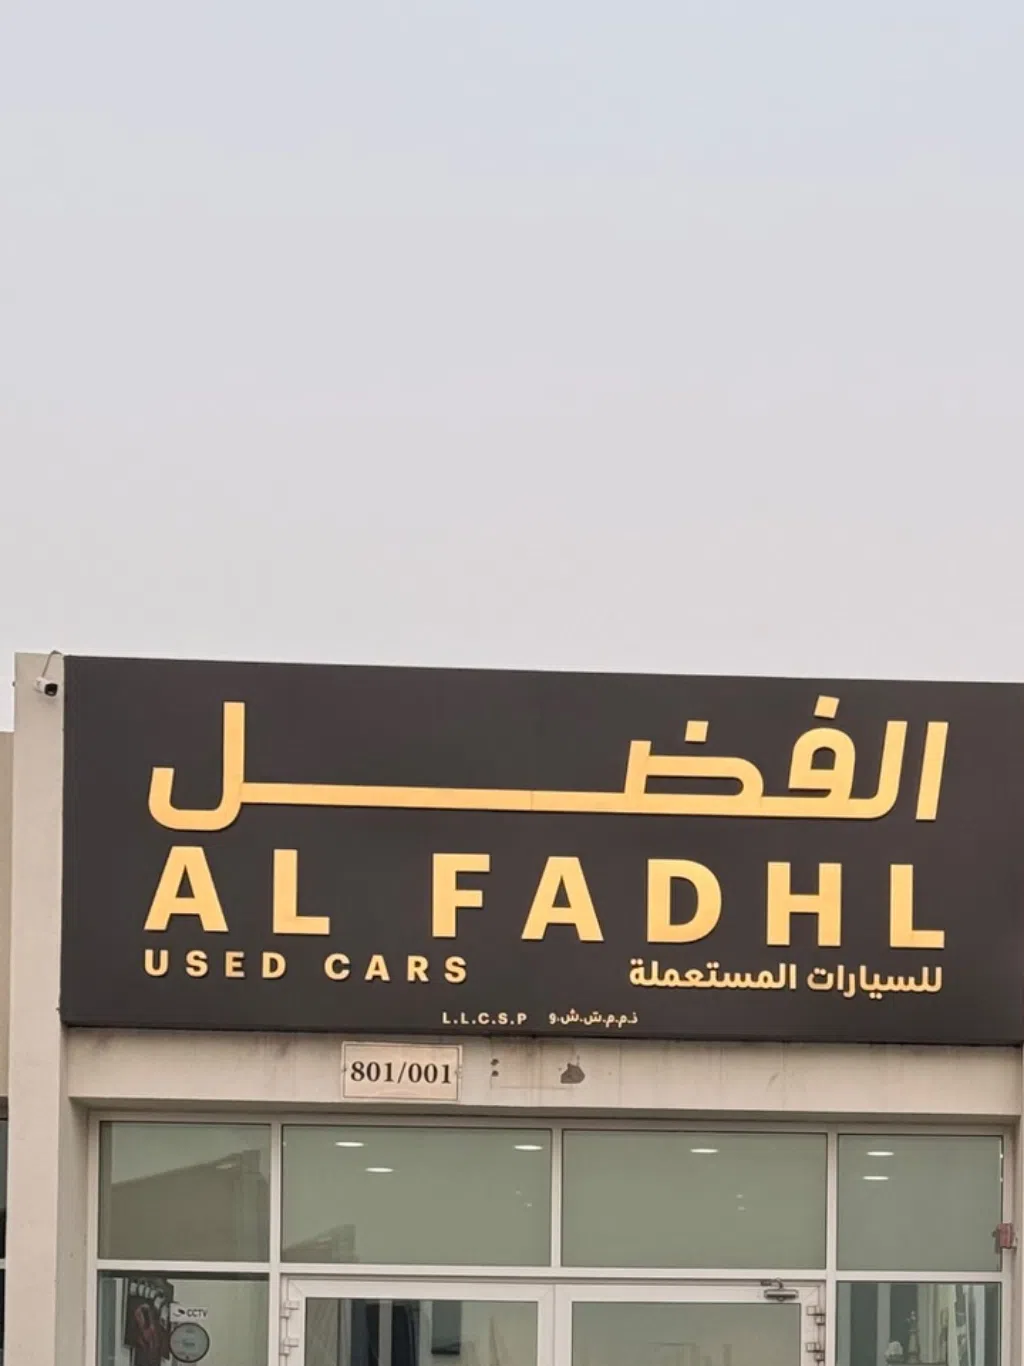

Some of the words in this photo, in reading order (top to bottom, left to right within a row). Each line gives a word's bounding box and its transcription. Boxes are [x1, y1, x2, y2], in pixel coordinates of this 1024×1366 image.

[147, 695, 949, 833] الفضل
[143, 845, 331, 936] AL
[431, 852, 946, 949] FADHL
[144, 949, 288, 980] USED
[323, 953, 467, 984] CARS
[628, 957, 797, 991] المستعملة
[806, 964, 943, 1001] للسيارات
[349, 1060, 453, 1086] 801/001
